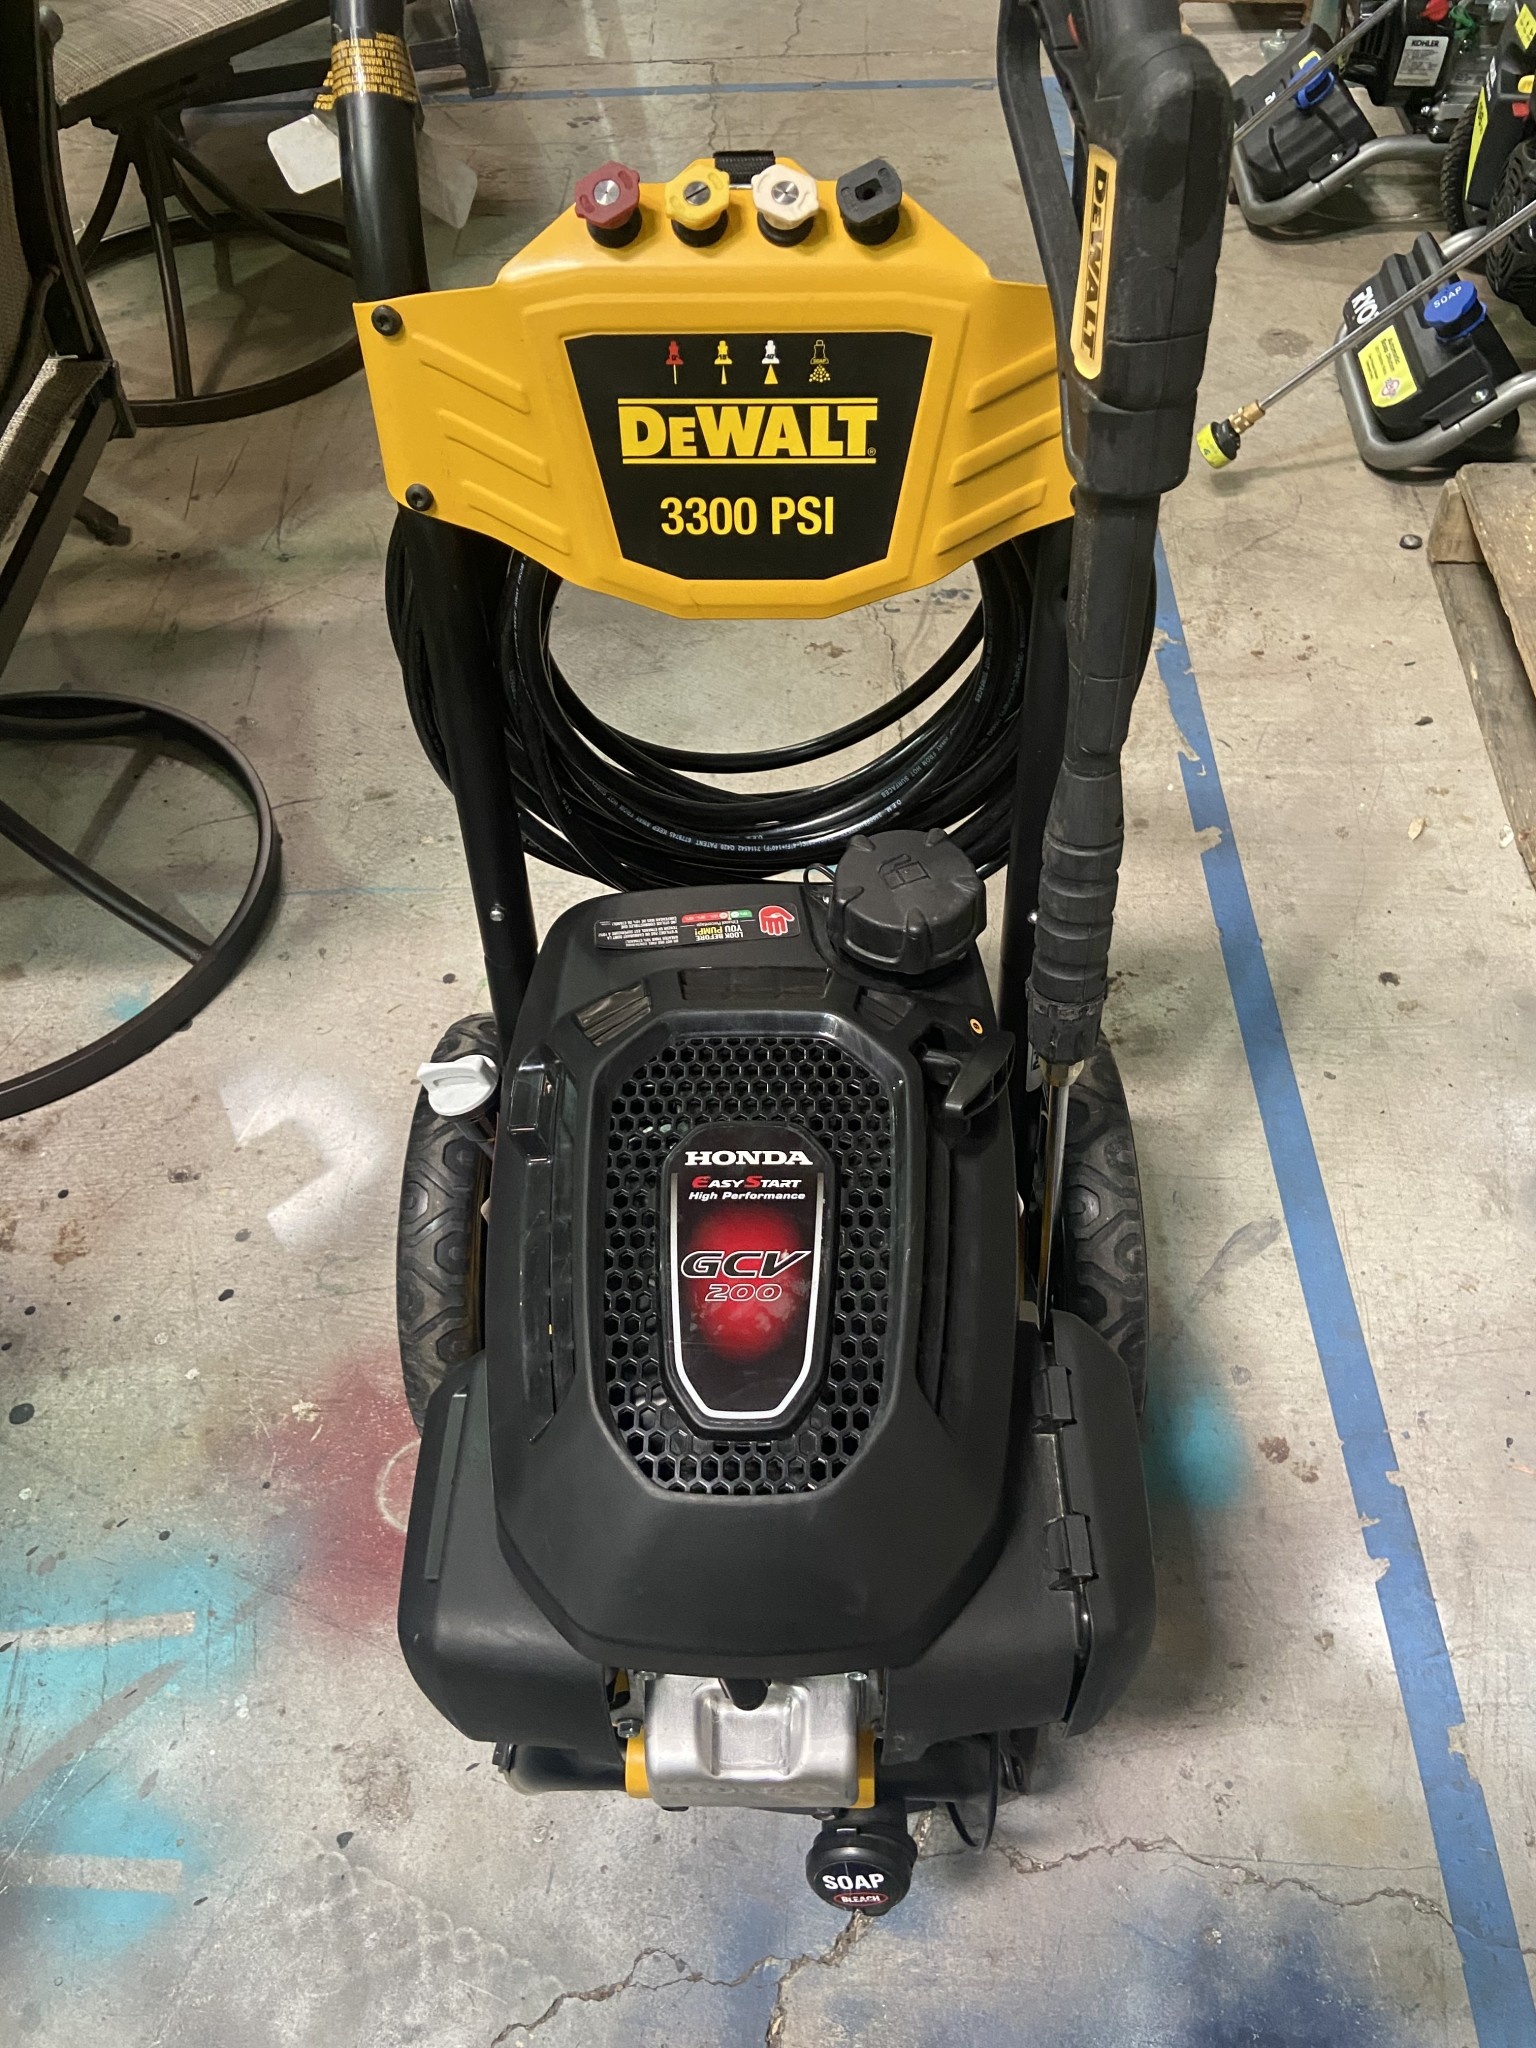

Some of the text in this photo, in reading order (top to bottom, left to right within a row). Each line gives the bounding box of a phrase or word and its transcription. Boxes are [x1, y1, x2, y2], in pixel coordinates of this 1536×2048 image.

[1081, 163, 1108, 360] DEWALT
[1433, 285, 1462, 309] SOAP
[617, 404, 878, 458] DEWALT
[659, 495, 834, 536] 3300 PSI
[921, 751, 937, 766] FROM
[910, 765, 922, 778] HOT
[880, 775, 910, 799] SURFACES
[651, 825, 668, 836] KEEP
[695, 840, 718, 849] PATENT
[694, 924, 743, 936] YOU PUMP!
[694, 931, 744, 942] LOOK BEFORE
[684, 1150, 814, 1166] HONDA
[688, 1191, 806, 1202] High Performance
[680, 1250, 812, 1279] GCV
[704, 1283, 783, 1302] 200
[822, 1873, 885, 1890] SOAP
[840, 1895, 880, 1903] BLEACH
